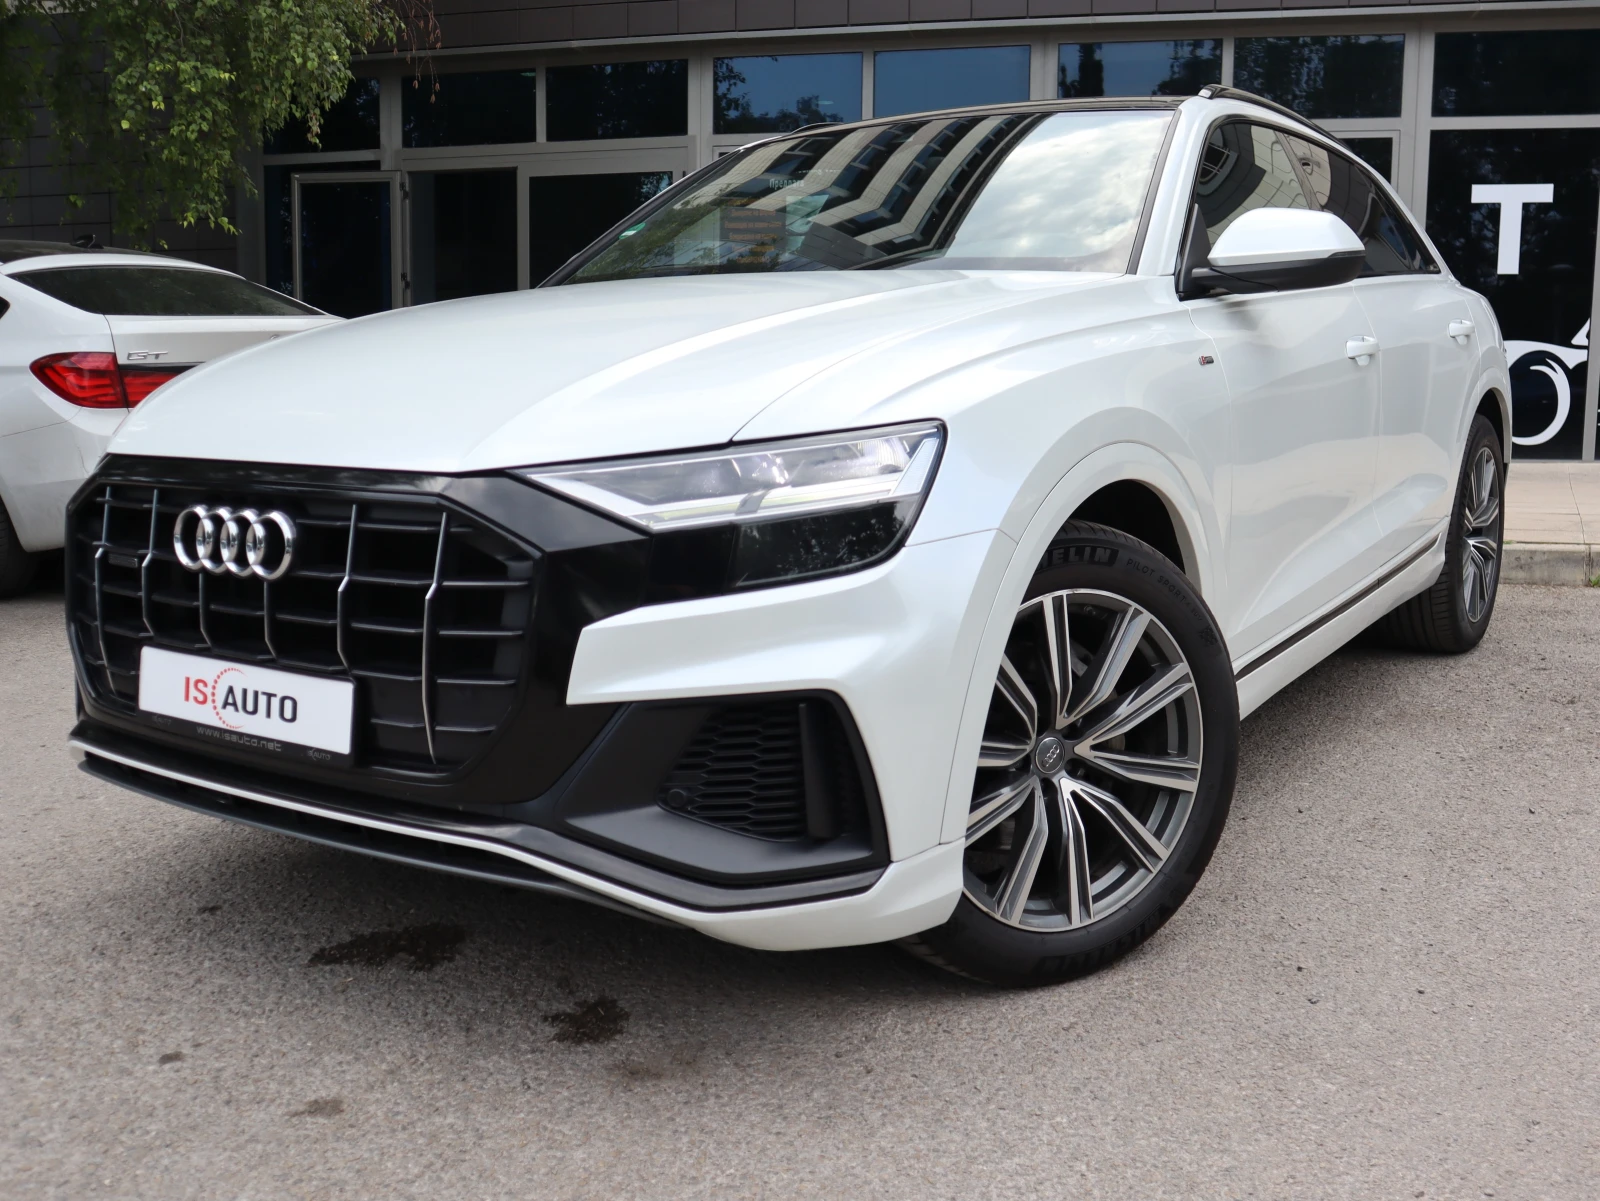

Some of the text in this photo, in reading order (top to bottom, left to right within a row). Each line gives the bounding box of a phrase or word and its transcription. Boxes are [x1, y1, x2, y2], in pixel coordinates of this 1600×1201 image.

[1471, 183, 1554, 275] T
[127, 350, 169, 360] GT
[1126, 558, 1155, 577] PILOT
[1157, 575, 1187, 603] SPORT
[183, 676, 298, 723] IS AUTO
[196, 726, 282, 751] www.isauto.net
